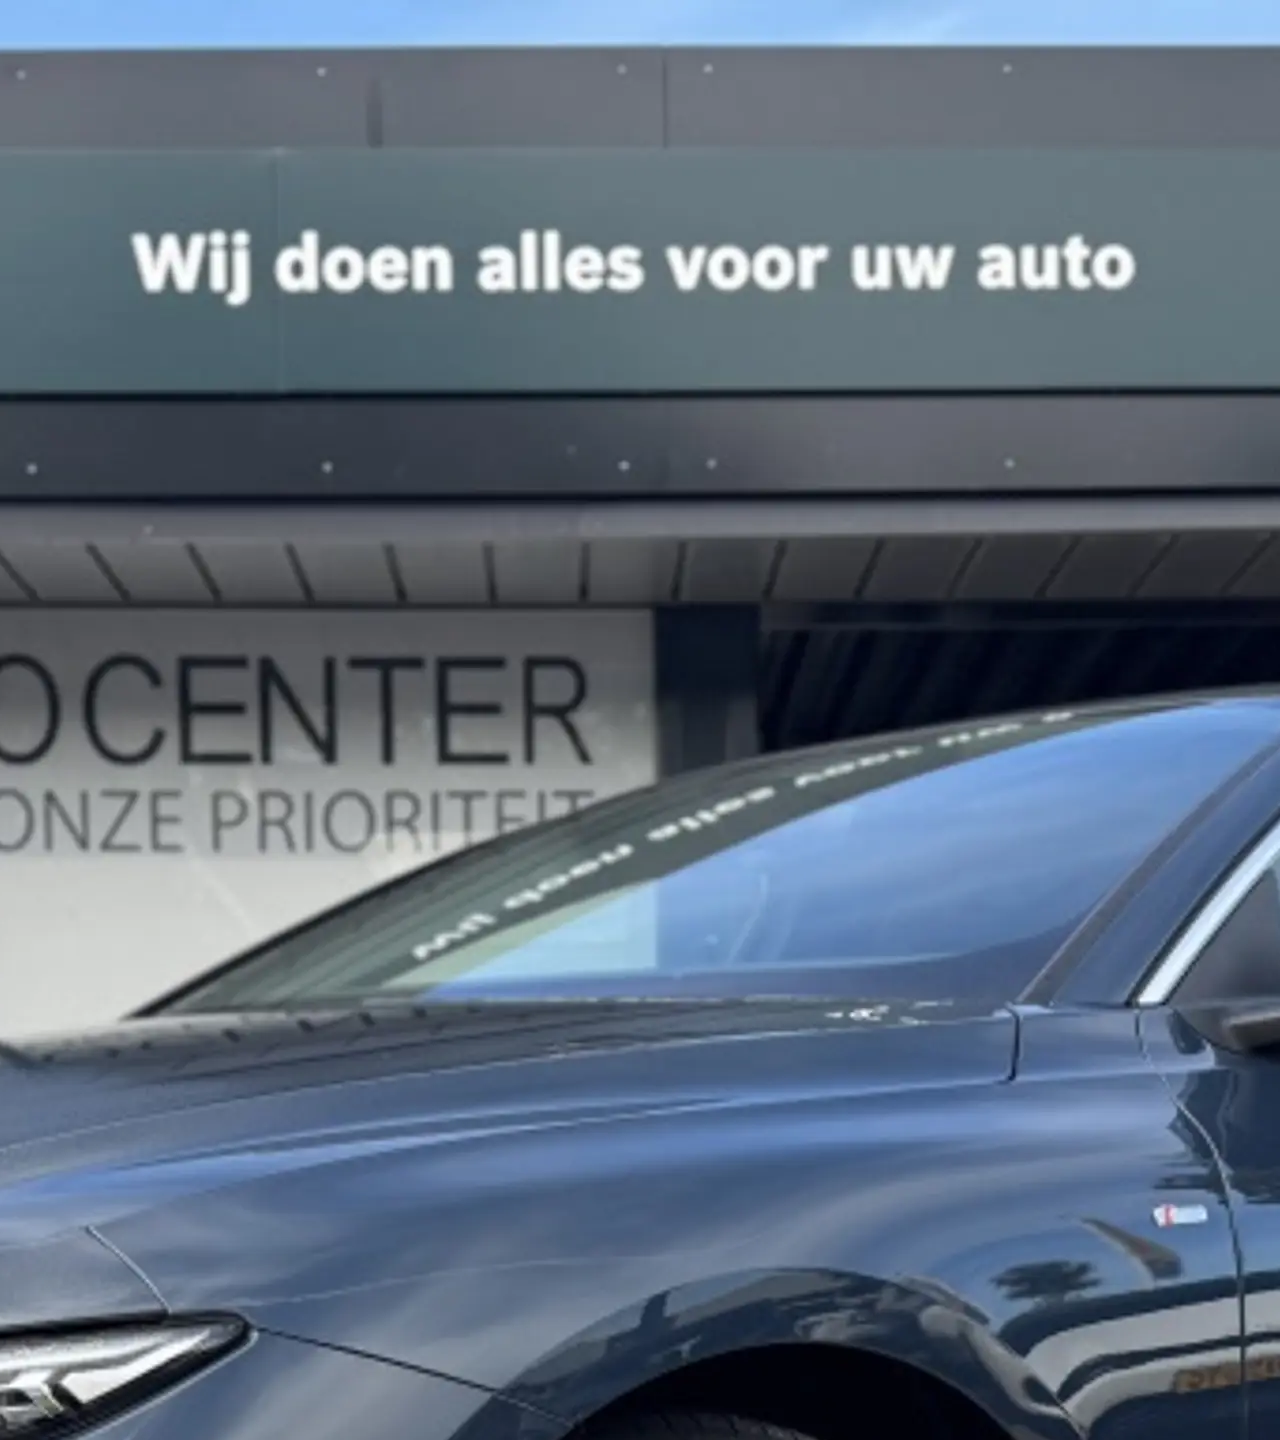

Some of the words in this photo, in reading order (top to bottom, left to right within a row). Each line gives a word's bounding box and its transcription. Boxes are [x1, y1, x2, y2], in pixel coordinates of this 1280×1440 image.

[130, 229, 252, 306] Wij
[274, 229, 454, 293] doen
[476, 228, 646, 293] alles
[665, 244, 830, 292] voor
[850, 244, 956, 292] uw
[976, 234, 1137, 291] auto
